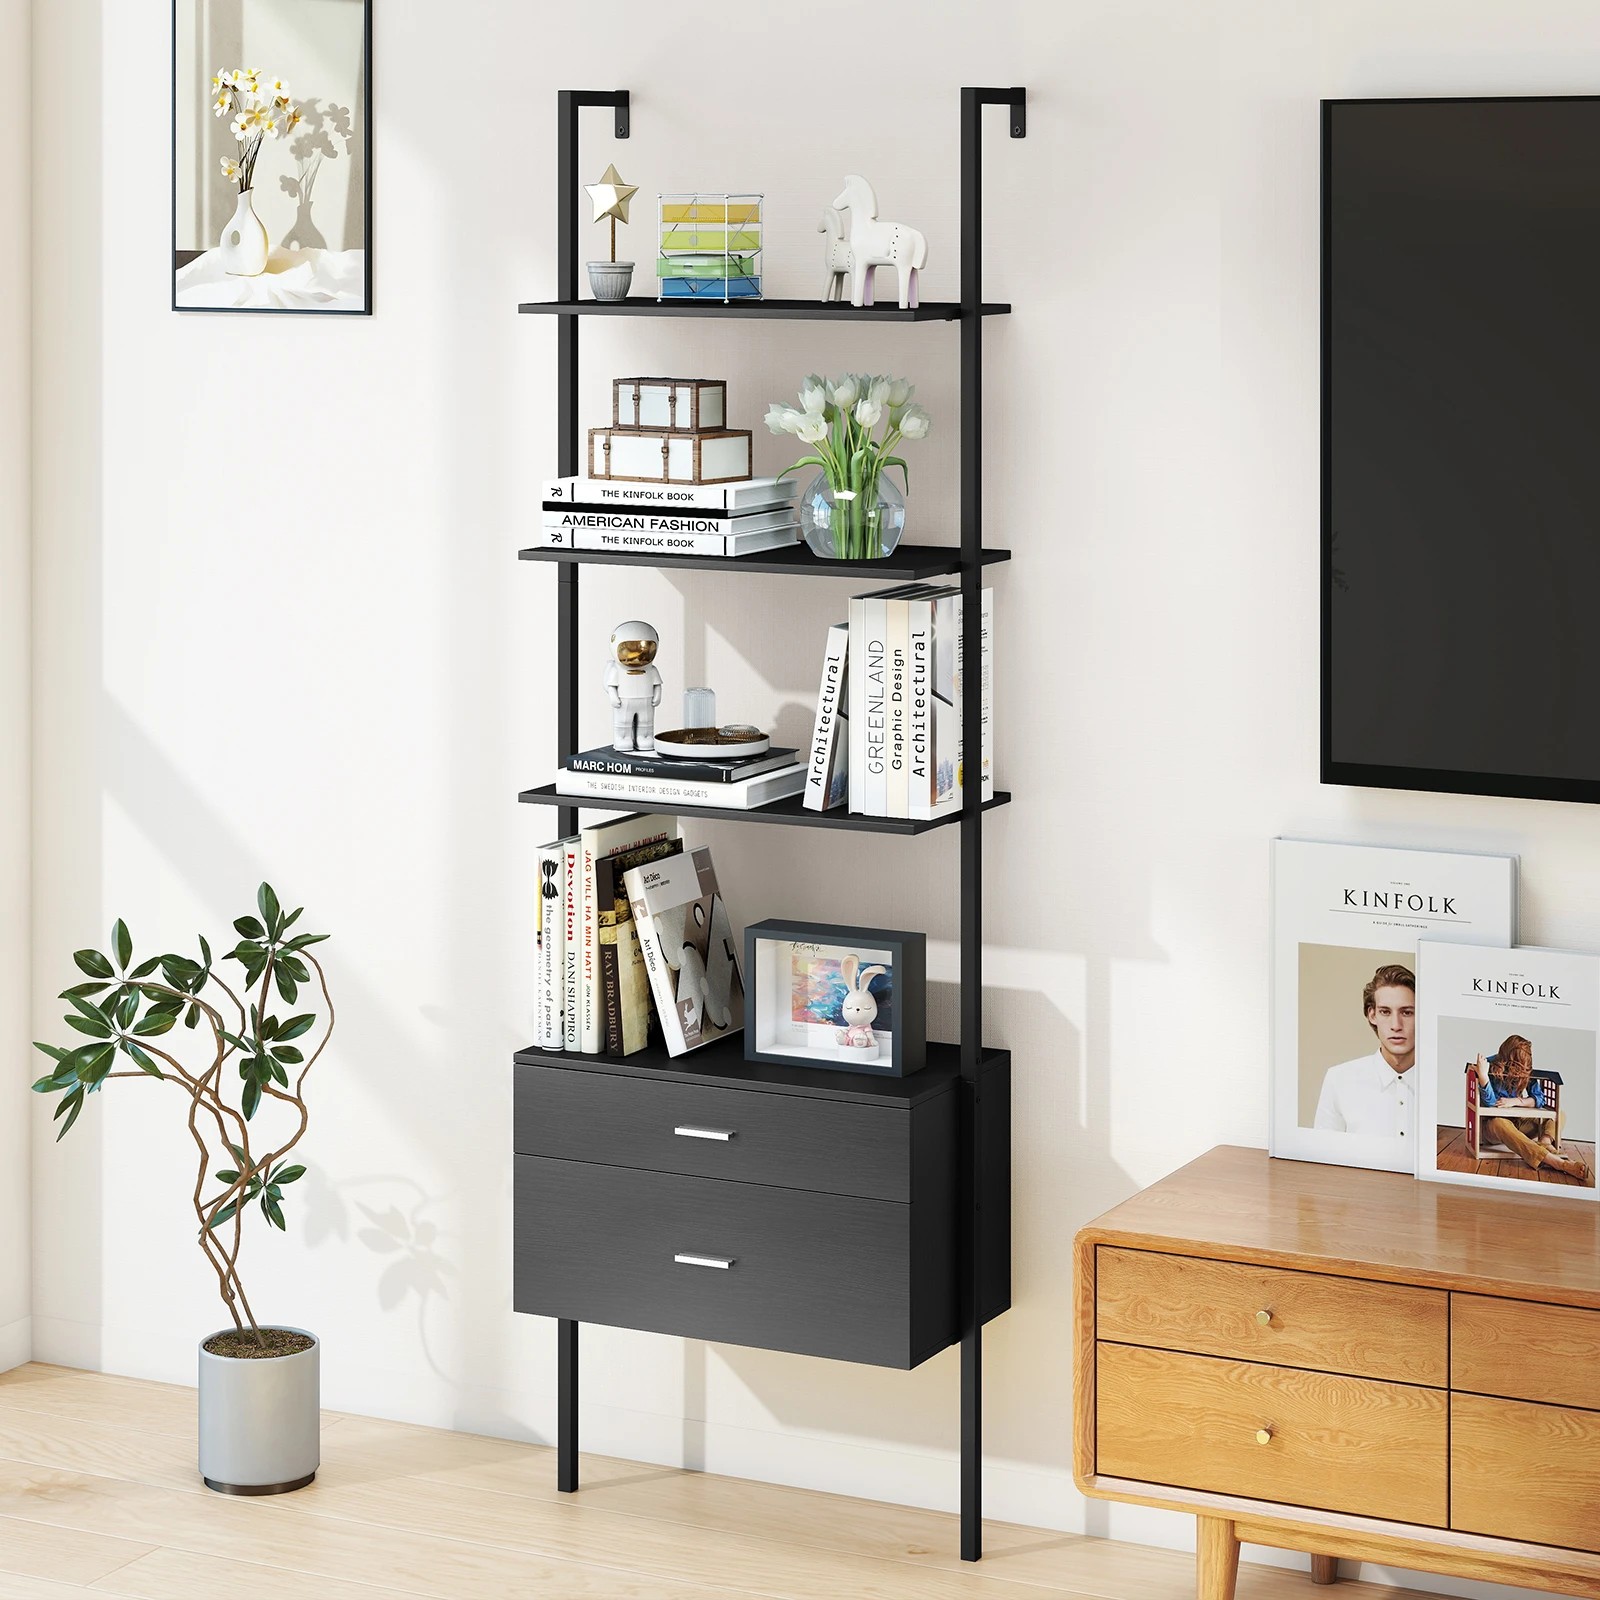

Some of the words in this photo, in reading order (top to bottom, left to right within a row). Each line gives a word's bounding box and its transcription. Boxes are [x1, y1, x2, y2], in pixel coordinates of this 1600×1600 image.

[601, 489, 620, 498] THE
[623, 490, 664, 500] KINFOLK
[667, 492, 695, 501] BOOK
[561, 514, 645, 529] AMERICAN
[650, 518, 719, 533] FASHION
[601, 535, 620, 544] THE
[623, 536, 664, 546] KINFOLK
[667, 538, 695, 548] BOOK
[891, 649, 905, 702] Design
[868, 640, 884, 774] GREENLAND
[912, 631, 926, 778] Architectural
[810, 656, 840, 787] Architectural
[891, 709, 905, 770] Graphic
[573, 760, 605, 772] MARC
[606, 762, 632, 774] HOM
[587, 781, 597, 789] THE
[601, 782, 625, 791] SWEDISH
[628, 784, 656, 794] INTERIOR
[659, 787, 681, 796] DESIGN
[683, 789, 708, 798] GADGETS
[567, 853, 576, 941] Devotion
[585, 905, 592, 922] HA
[1343, 888, 1457, 915] KINFOLK
[545, 904, 554, 924] the
[544, 927, 553, 986] geometry
[567, 951, 576, 984] DANI
[604, 951, 614, 978] RAY
[643, 938, 651, 951] Art
[647, 951, 657, 972] Déco
[545, 989, 554, 1002] of
[1472, 978, 1560, 999] KINFOLK
[544, 1005, 553, 1039] pasta
[567, 986, 576, 1043] SHAPIRO
[606, 981, 619, 1052] BRADBURY
